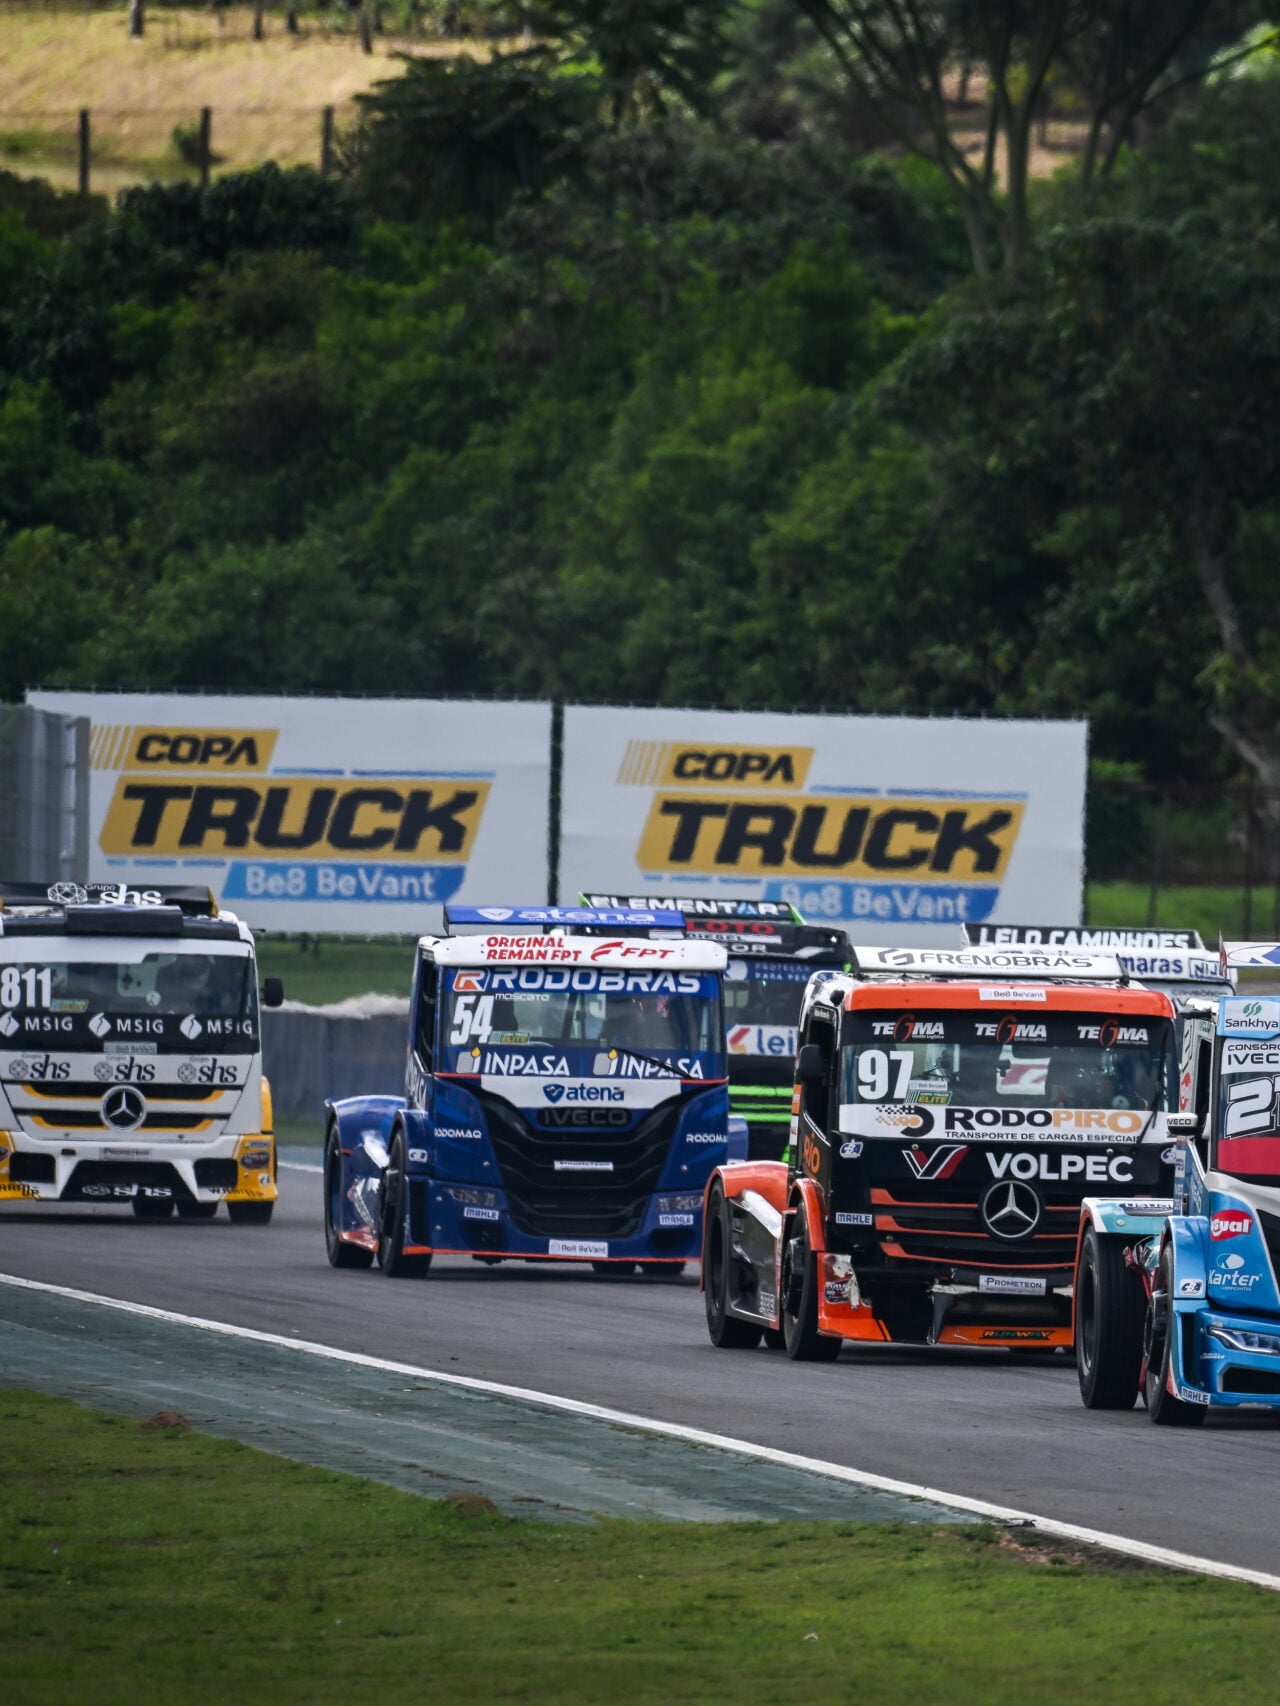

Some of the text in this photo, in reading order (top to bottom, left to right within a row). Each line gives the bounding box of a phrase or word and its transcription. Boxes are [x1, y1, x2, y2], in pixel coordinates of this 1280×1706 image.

[136, 734, 259, 765] COPA
[673, 750, 795, 783] COPA
[123, 785, 479, 853] TRUCK
[659, 801, 1013, 874] TRUCK
[100, 883, 162, 905] shs
[245, 866, 437, 899] Be8 BeVant
[853, 886, 968, 921] BeVant
[486, 937, 564, 948] ORIGINAL
[621, 948, 675, 959] FPT
[486, 949, 582, 961] REMAN FPT
[920, 953, 1093, 969] FRENOBRAS
[0, 967, 51, 1009] 811
[491, 967, 700, 994] RODOBRAS
[993, 990, 1044, 1000] Be8 BeVant
[25, 1016, 73, 1032] MSIG
[117, 1018, 164, 1034] MSIG
[207, 1019, 253, 1035] MSIG
[450, 995, 494, 1045] 54
[872, 1015, 945, 1042] TEGMA
[975, 1016, 1047, 1043] TEGMA
[1225, 1018, 1279, 1030] Sankhya
[1077, 1018, 1149, 1046] TEGMA
[30, 1054, 70, 1081] shs
[114, 1056, 156, 1082] shs
[198, 1058, 237, 1084] shs
[484, 1053, 570, 1076] INPASA
[620, 1054, 704, 1079] INPASA
[858, 1050, 914, 1100] 97
[566, 1083, 625, 1101] atena
[544, 1108, 627, 1125] IVECO
[945, 1108, 1142, 1133] RODOPIRO
[945, 1131, 1017, 1140] TRANSPORTE
[1039, 1134, 1084, 1142] CARGAS
[1087, 1135, 1140, 1143] ESPECIAIS
[986, 1152, 1134, 1181] VOLPEC
[466, 1208, 498, 1219] MAHLE
[660, 1215, 694, 1225] MAHLE
[838, 1214, 871, 1224] MAHLE
[984, 1277, 1042, 1288] PROMETEON
[1208, 1269, 1260, 1287] Karter
[1182, 1388, 1209, 1404] MAHLE
